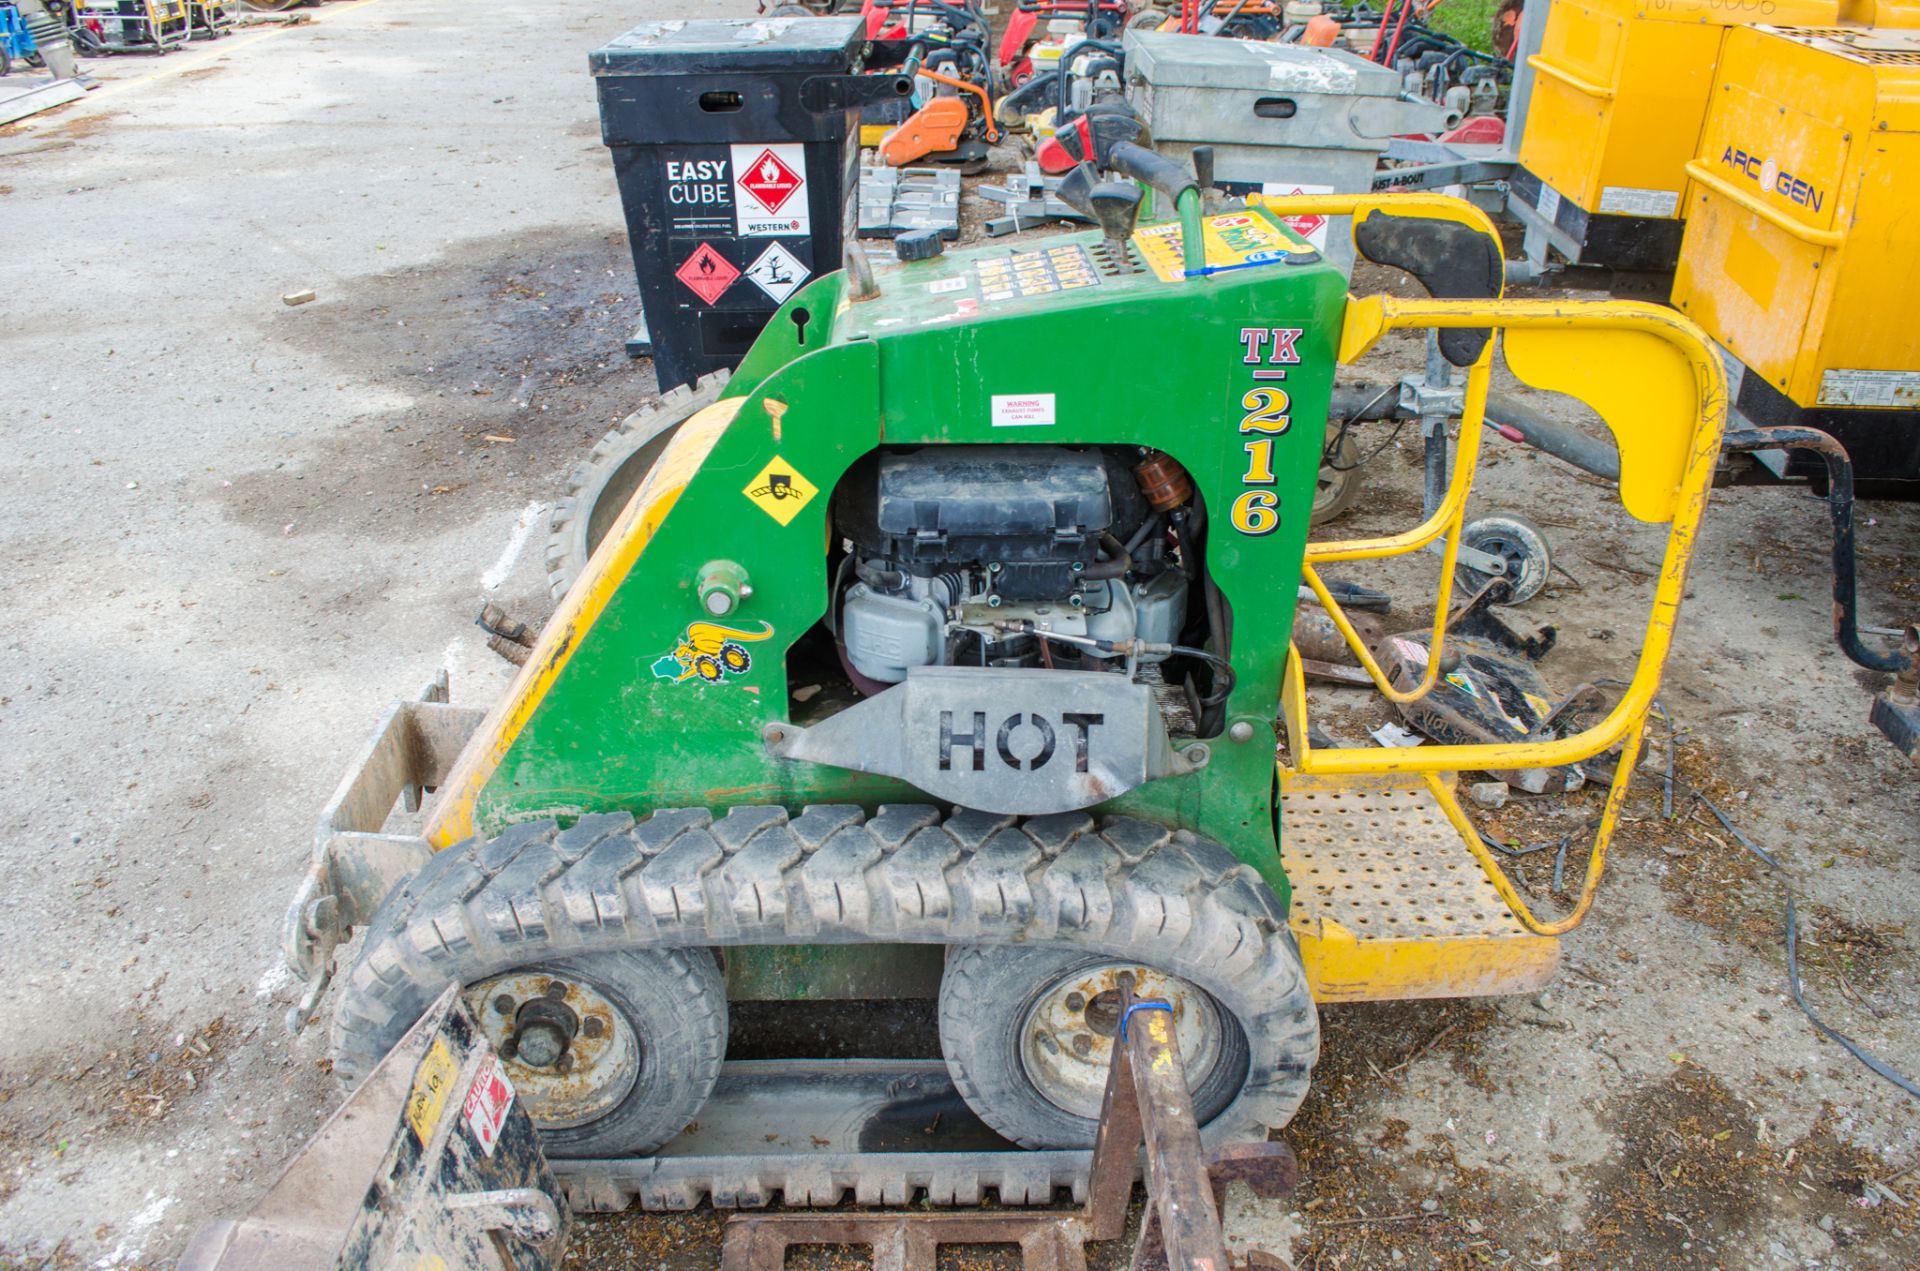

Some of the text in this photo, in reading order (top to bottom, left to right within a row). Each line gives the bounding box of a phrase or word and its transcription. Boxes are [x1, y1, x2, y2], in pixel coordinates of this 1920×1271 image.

[667, 160, 727, 181] EASY
[669, 184, 730, 204] CUBE
[748, 222, 790, 231] WESTERN
[939, 711, 1104, 773] HOT
